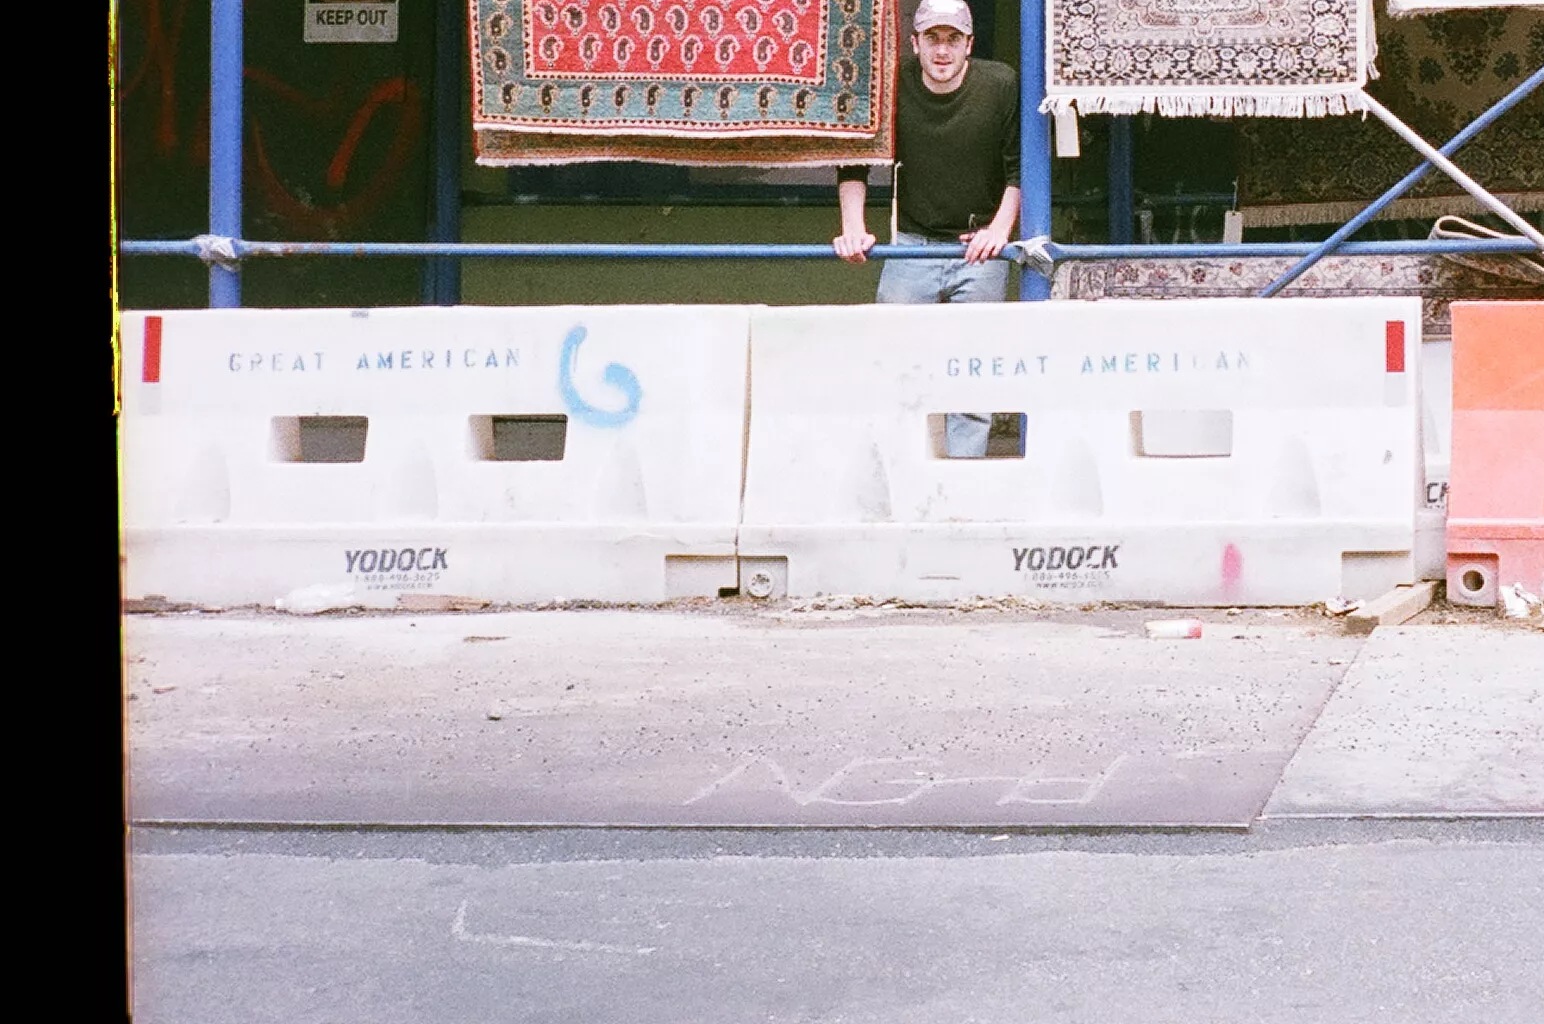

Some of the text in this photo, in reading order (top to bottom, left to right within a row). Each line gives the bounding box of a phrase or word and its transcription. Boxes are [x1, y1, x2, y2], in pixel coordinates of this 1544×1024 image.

[316, 10, 388, 26] KEEP OUT
[229, 347, 520, 372] GREAT AMERICAN
[946, 355, 1049, 377] GREAT
[345, 547, 449, 573] YODOCK
[1012, 545, 1119, 571] YODOCK
